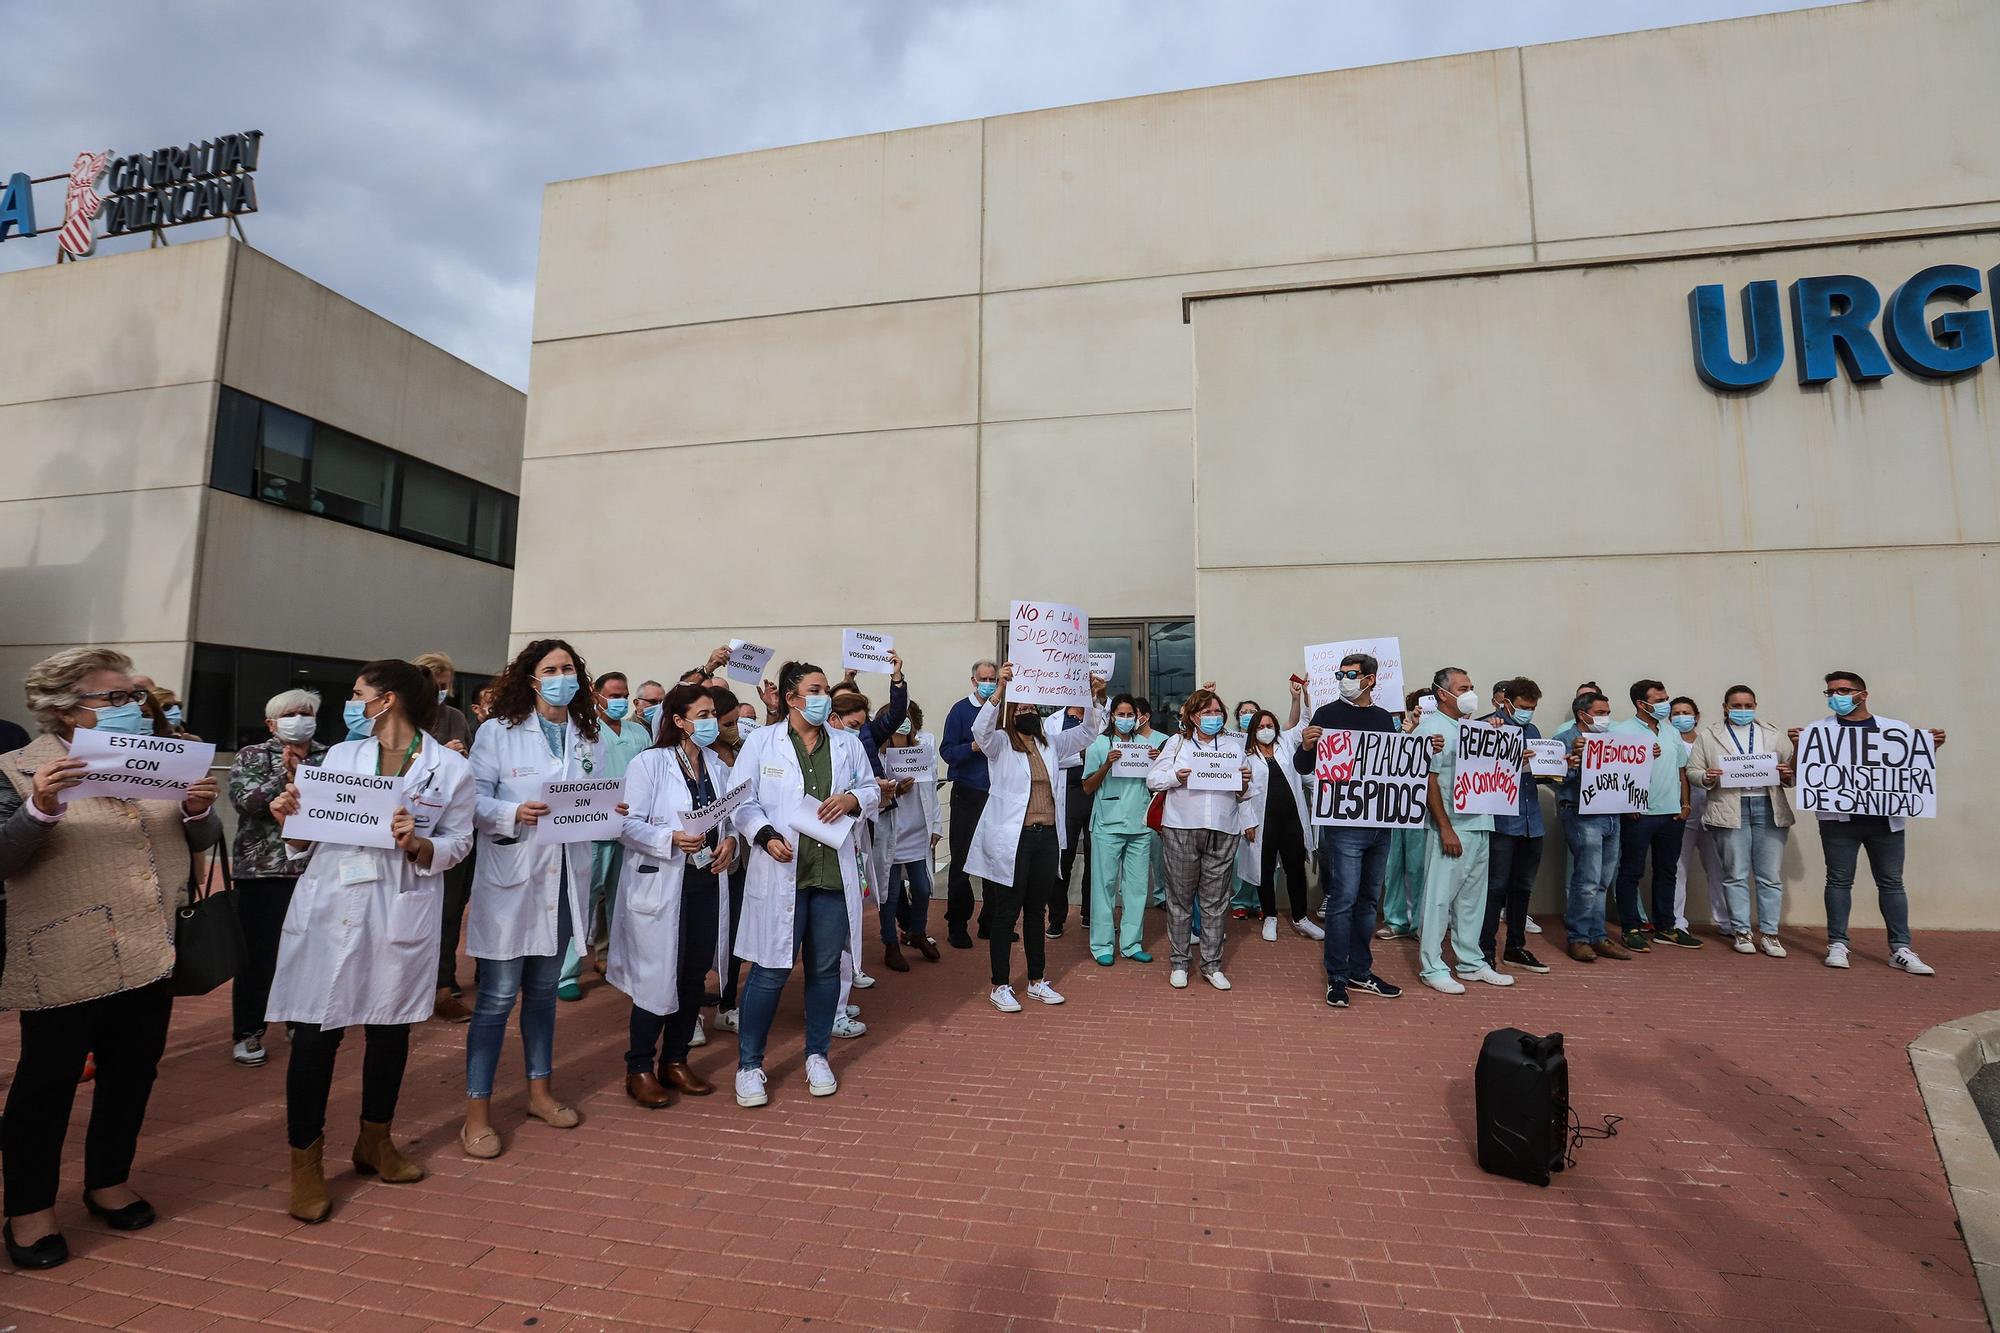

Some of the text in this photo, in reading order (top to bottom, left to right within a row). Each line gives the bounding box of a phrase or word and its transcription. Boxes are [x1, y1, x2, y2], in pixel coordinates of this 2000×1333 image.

[108, 129, 264, 195] GENERALITAT
[104, 173, 258, 235] VALENCIANA
[1687, 263, 2000, 392] URG
[1015, 603, 1073, 624] NO A LA
[856, 632, 883, 643] ESTAMOS
[742, 643, 767, 655] ESTAMOS
[742, 653, 754, 661] CON
[848, 651, 890, 663] VOSOTROS/AS
[1072, 668, 1081, 681] 15
[109, 736, 185, 754] ESTAMOS
[1316, 730, 1352, 761] AYER
[1458, 724, 1524, 773] REVERSIÓN
[1586, 738, 1647, 770] MÉDICOS
[1800, 726, 1936, 769] AVIESA
[1192, 751, 1238, 759] SUBROGACIÓN
[1350, 731, 1433, 780] APLAUSOS
[1723, 753, 1773, 762] SUBROGACIÓN
[125, 758, 160, 772] CON
[890, 765, 928, 774] VOSOTROS/AS
[303, 769, 394, 790] SUBROGACIÓN
[1196, 771, 1233, 779] CONDICIÓN
[1315, 758, 1354, 793] HOY
[1730, 771, 1770, 779] CONDICIÓN
[1804, 762, 1934, 794] CONSELLERA
[548, 780, 620, 794] SUBROGACIÓN
[1582, 784, 1597, 806] DE
[1596, 772, 1619, 792] USAR
[1627, 779, 1649, 811] TIRAR
[335, 792, 357, 804] SIN
[574, 798, 591, 807] SIN
[684, 783, 747, 820] SUBROGACIÓN
[1315, 779, 1426, 825] DESPIDOS
[1802, 787, 1924, 818] DE SANIDAD
[308, 808, 379, 826] CONDICIÓN
[553, 811, 609, 825] CONDICIÓN
[713, 807, 727, 820] SIN
